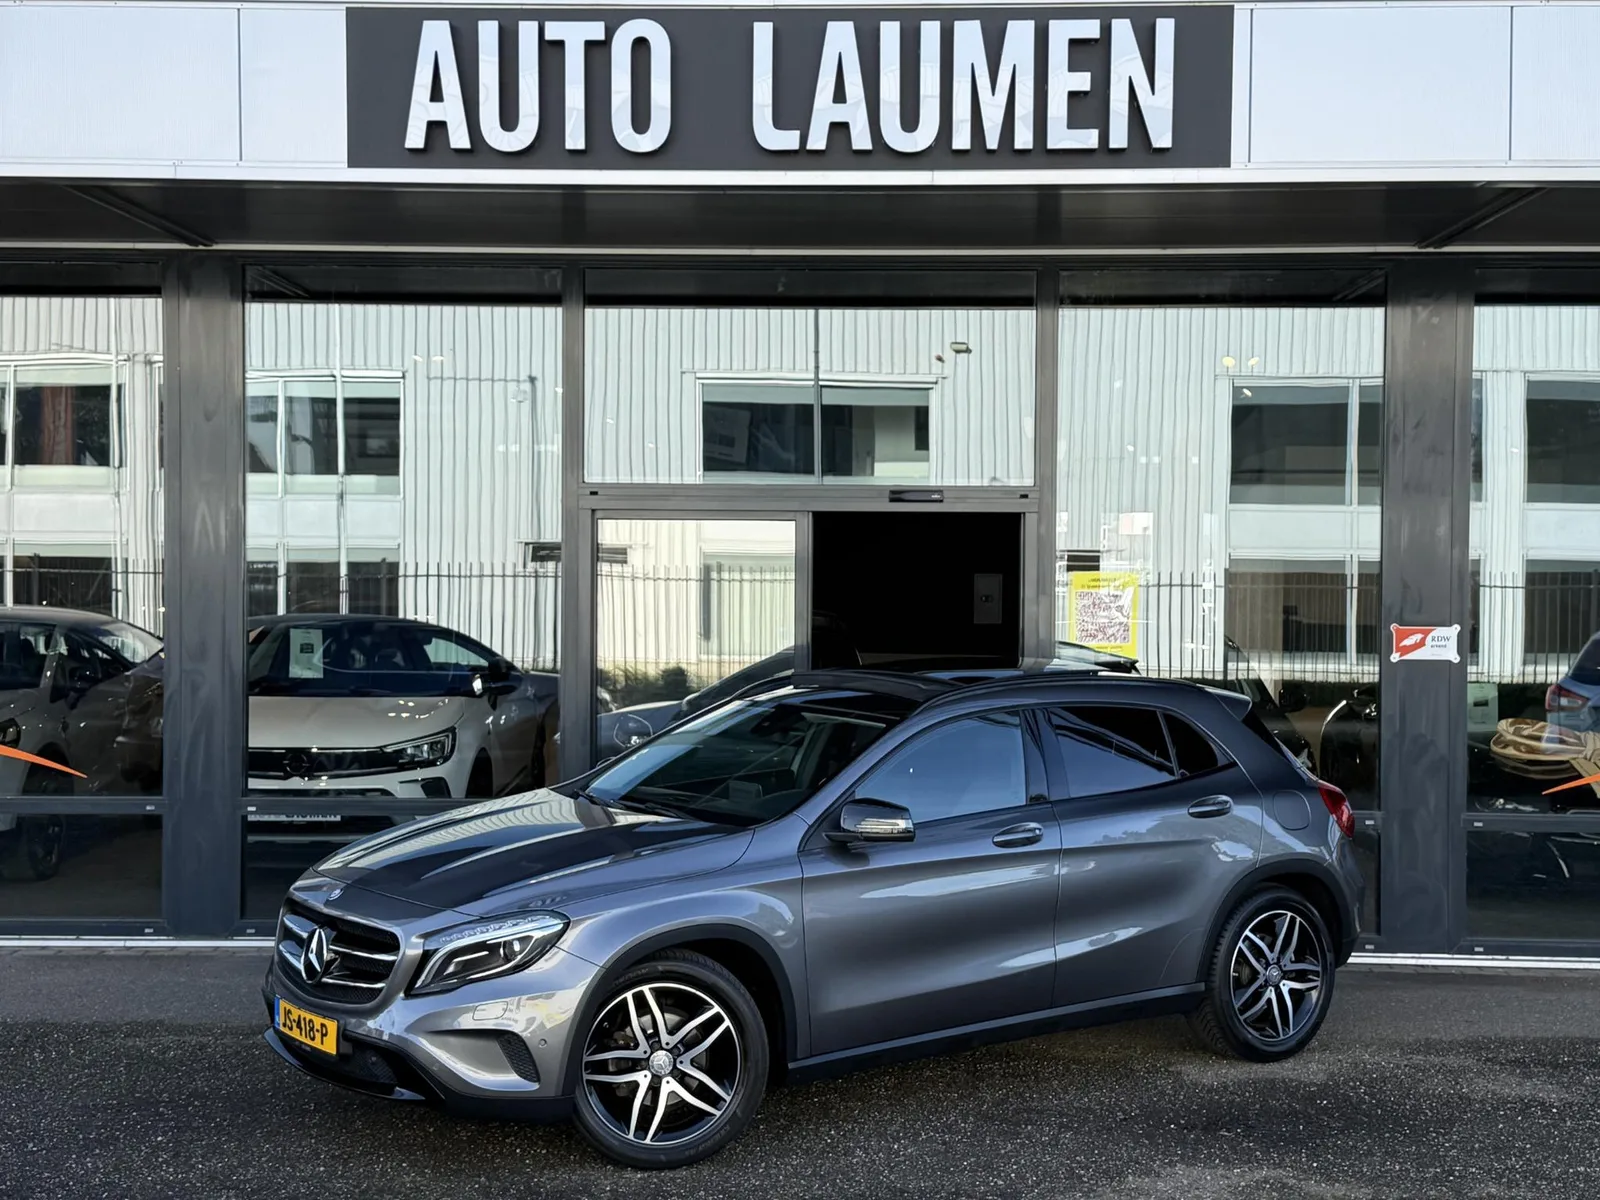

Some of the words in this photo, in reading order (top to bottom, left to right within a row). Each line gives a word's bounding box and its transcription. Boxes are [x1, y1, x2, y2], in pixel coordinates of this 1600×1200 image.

[404, 18, 672, 154] AUTO
[752, 17, 1176, 154] LAUMEN
[1431, 635, 1452, 643] RDW
[281, 1006, 329, 1046] JS-418-P
